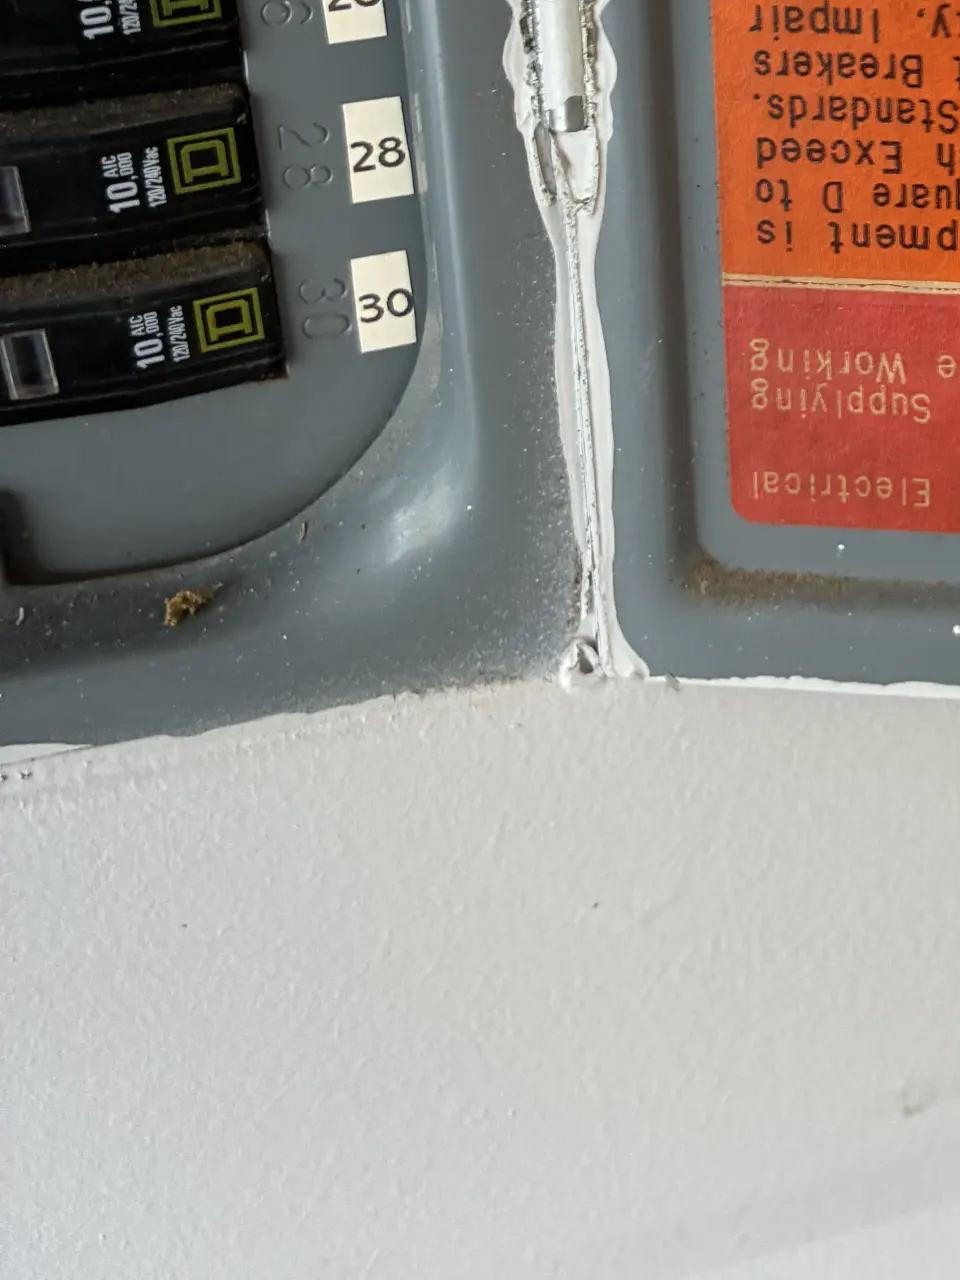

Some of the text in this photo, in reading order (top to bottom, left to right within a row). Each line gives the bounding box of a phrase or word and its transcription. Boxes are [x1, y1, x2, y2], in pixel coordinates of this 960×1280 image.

[749, 0, 880, 43] Impair
[754, 50, 924, 89] Breakers
[752, 93, 959, 134] Standards.
[102, 155, 119, 178] AIC
[277, 122, 333, 190] 28
[351, 137, 406, 174] 28
[755, 137, 904, 175] Exceed
[755, 178, 792, 212] to
[822, 181, 844, 214] D
[756, 220, 793, 252] is
[298, 277, 352, 340] 30
[359, 287, 414, 323] 30
[130, 315, 145, 337] AIC
[749, 338, 906, 385] Working
[750, 378, 931, 423] Supplying
[752, 471, 931, 507] Electrical
